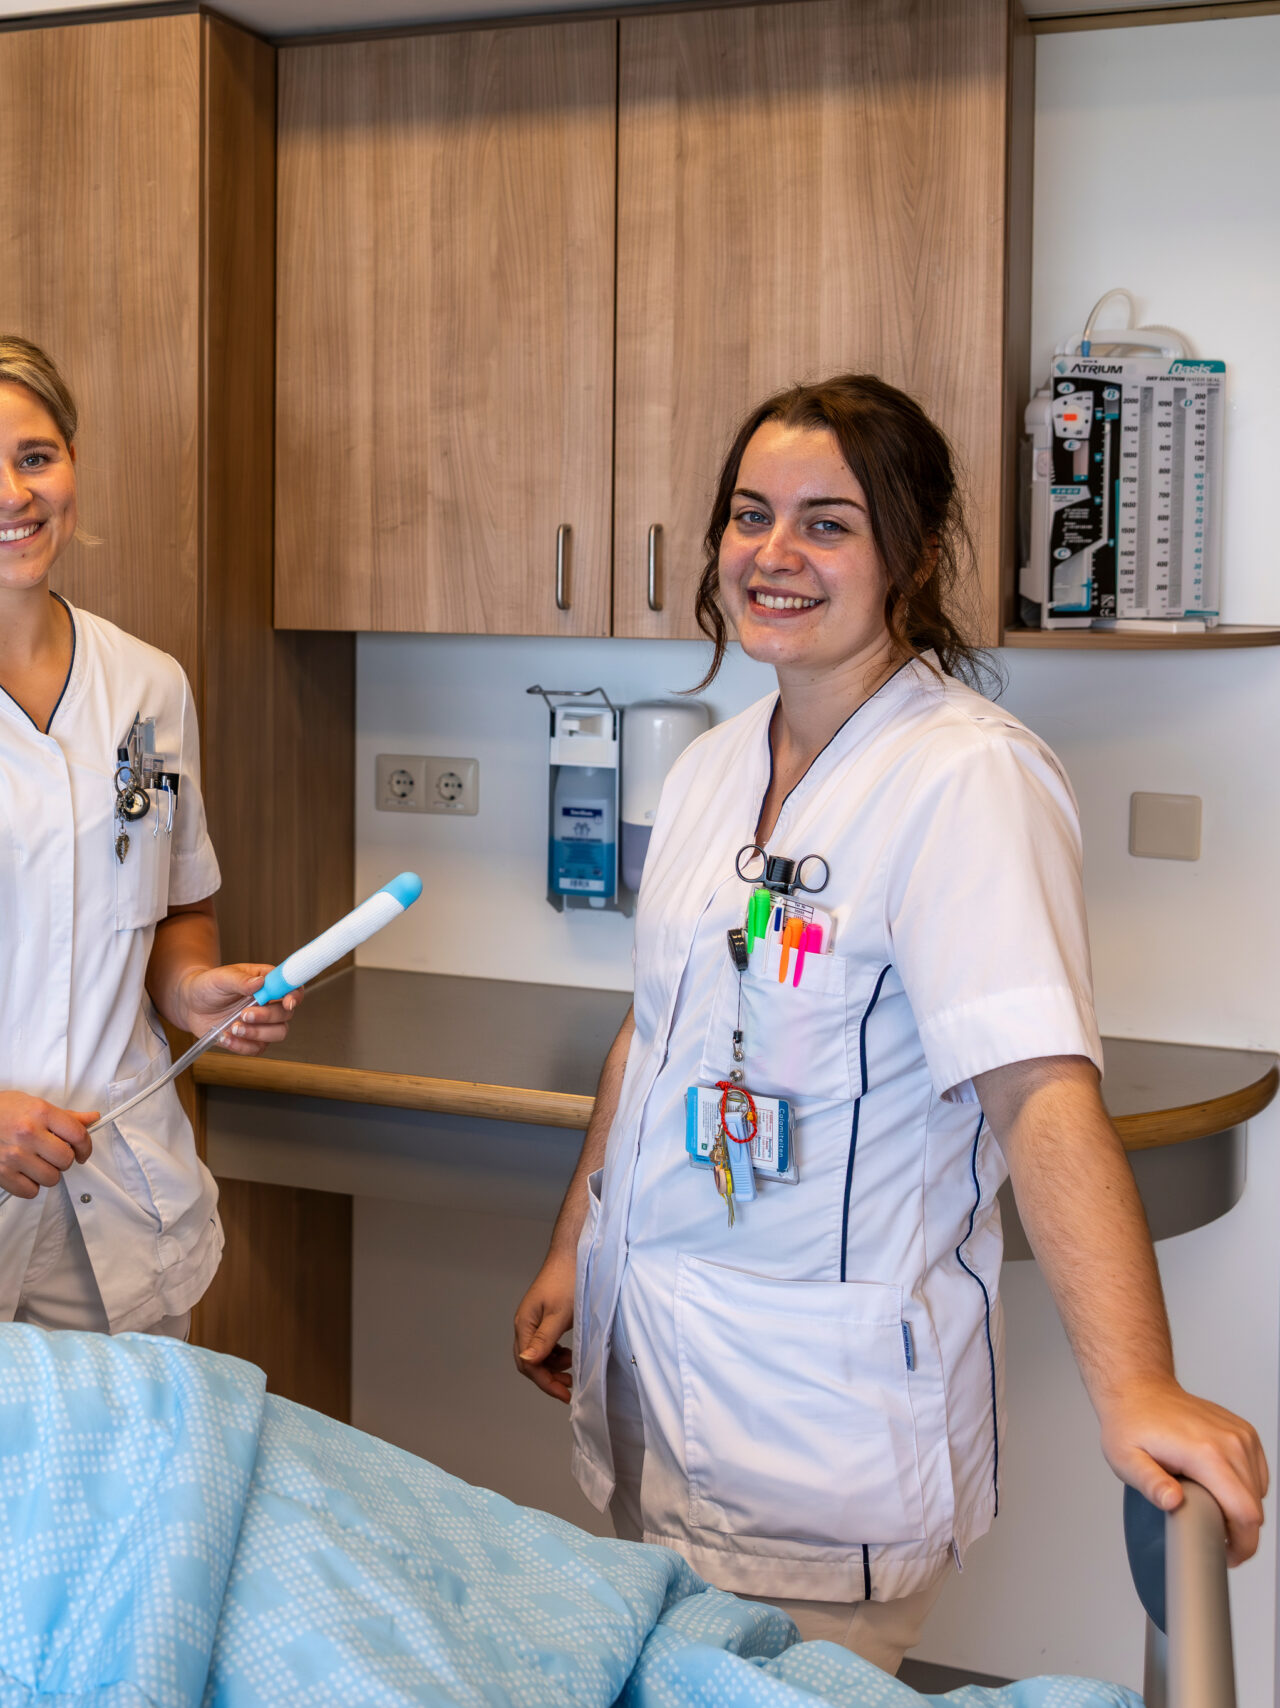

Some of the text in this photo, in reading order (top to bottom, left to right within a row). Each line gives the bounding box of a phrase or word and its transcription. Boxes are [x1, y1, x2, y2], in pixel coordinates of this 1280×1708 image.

[1071, 363, 1123, 375] ATRIUM
[1172, 362, 1211, 375] Oasis
[1195, 393, 1207, 401] 200
[778, 1108, 786, 1158] Calamiteiten
